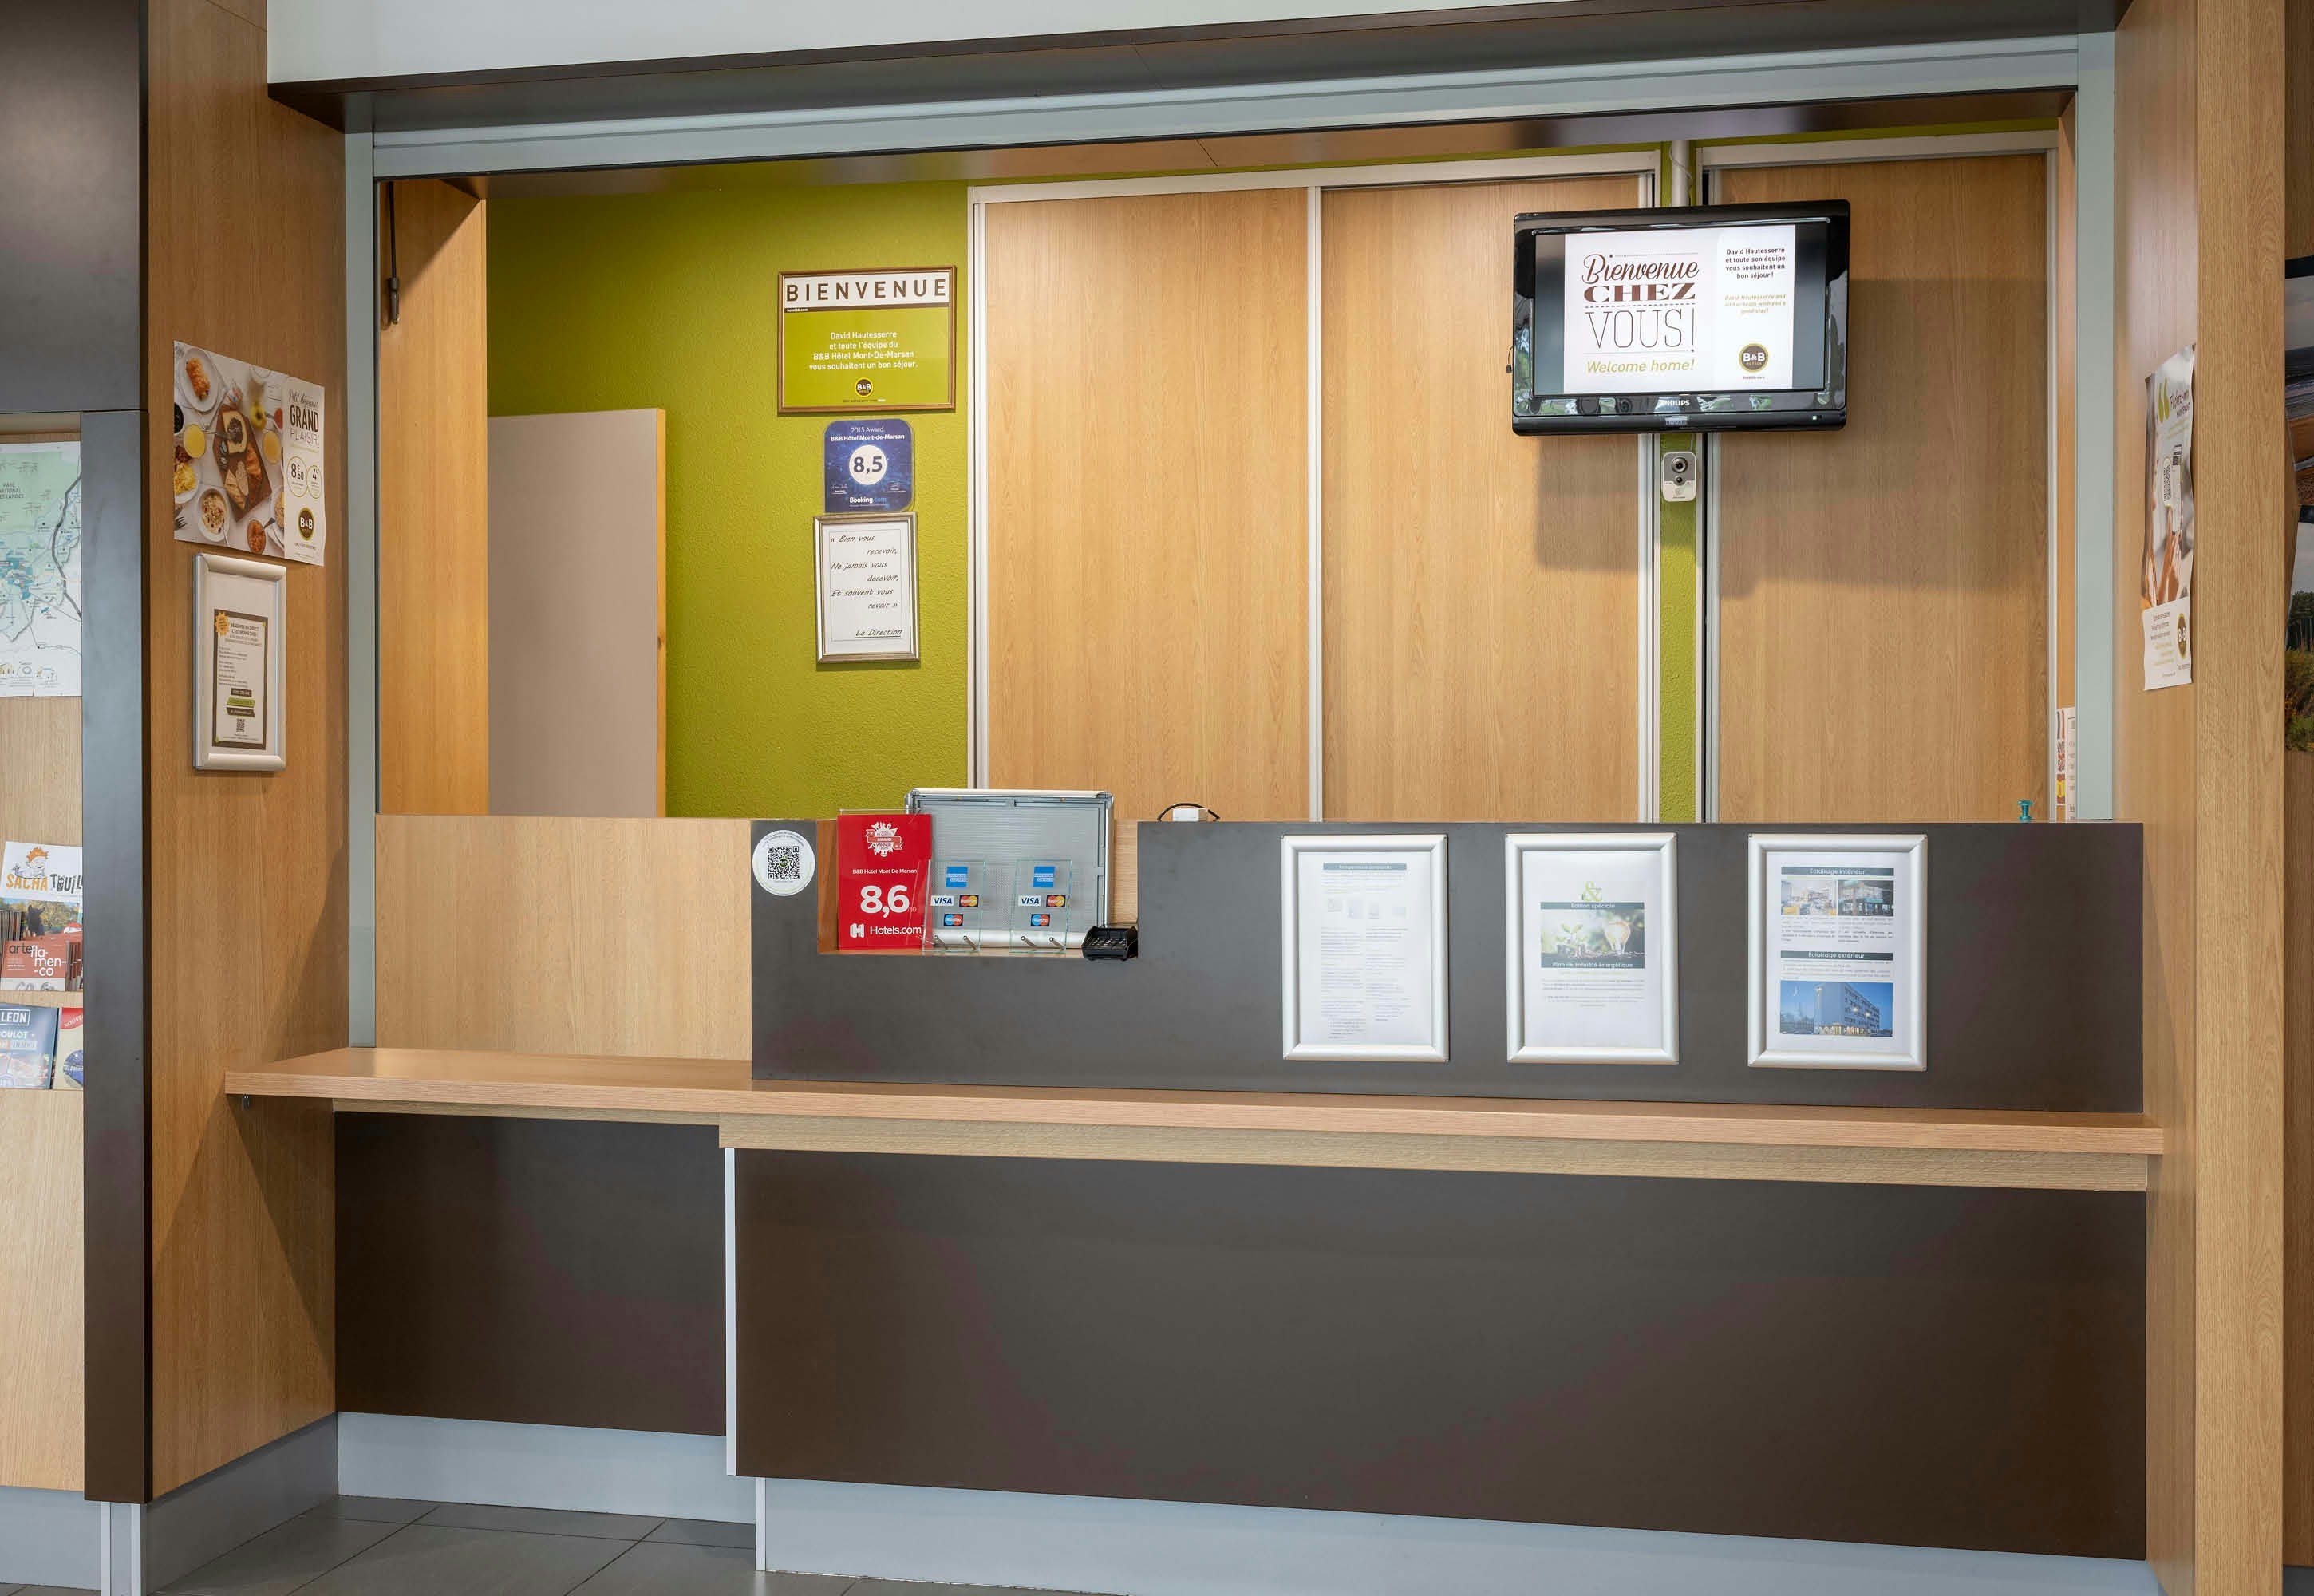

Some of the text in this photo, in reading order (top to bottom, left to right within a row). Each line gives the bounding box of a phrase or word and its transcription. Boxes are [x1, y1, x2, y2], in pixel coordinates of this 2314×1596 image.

[1582, 254, 1700, 284] Bienvenue
[786, 279, 946, 302] BIENVENUE
[1583, 282, 1696, 303] CHEZ
[830, 330, 898, 340] David Hautesserre
[831, 351, 851, 360] Hôtel
[852, 350, 914, 359] Mont-De-Marsan
[1742, 352, 1766, 362] B&B
[827, 361, 866, 370] souhaitent
[1585, 358, 1696, 374] Welcome home!
[290, 404, 319, 433] GRAND
[853, 456, 883, 474] 8,5
[300, 516, 313, 530] B&B
[843, 562, 868, 571] jamais
[844, 588, 875, 597] souvent
[867, 628, 902, 637] Direction
[6, 873, 83, 894] SACHA TOUIL
[860, 884, 910, 918] 8,6
[870, 925, 922, 935] Hotels.com
[9, 942, 33, 954] arte
[1, 1011, 27, 1023] LEON
